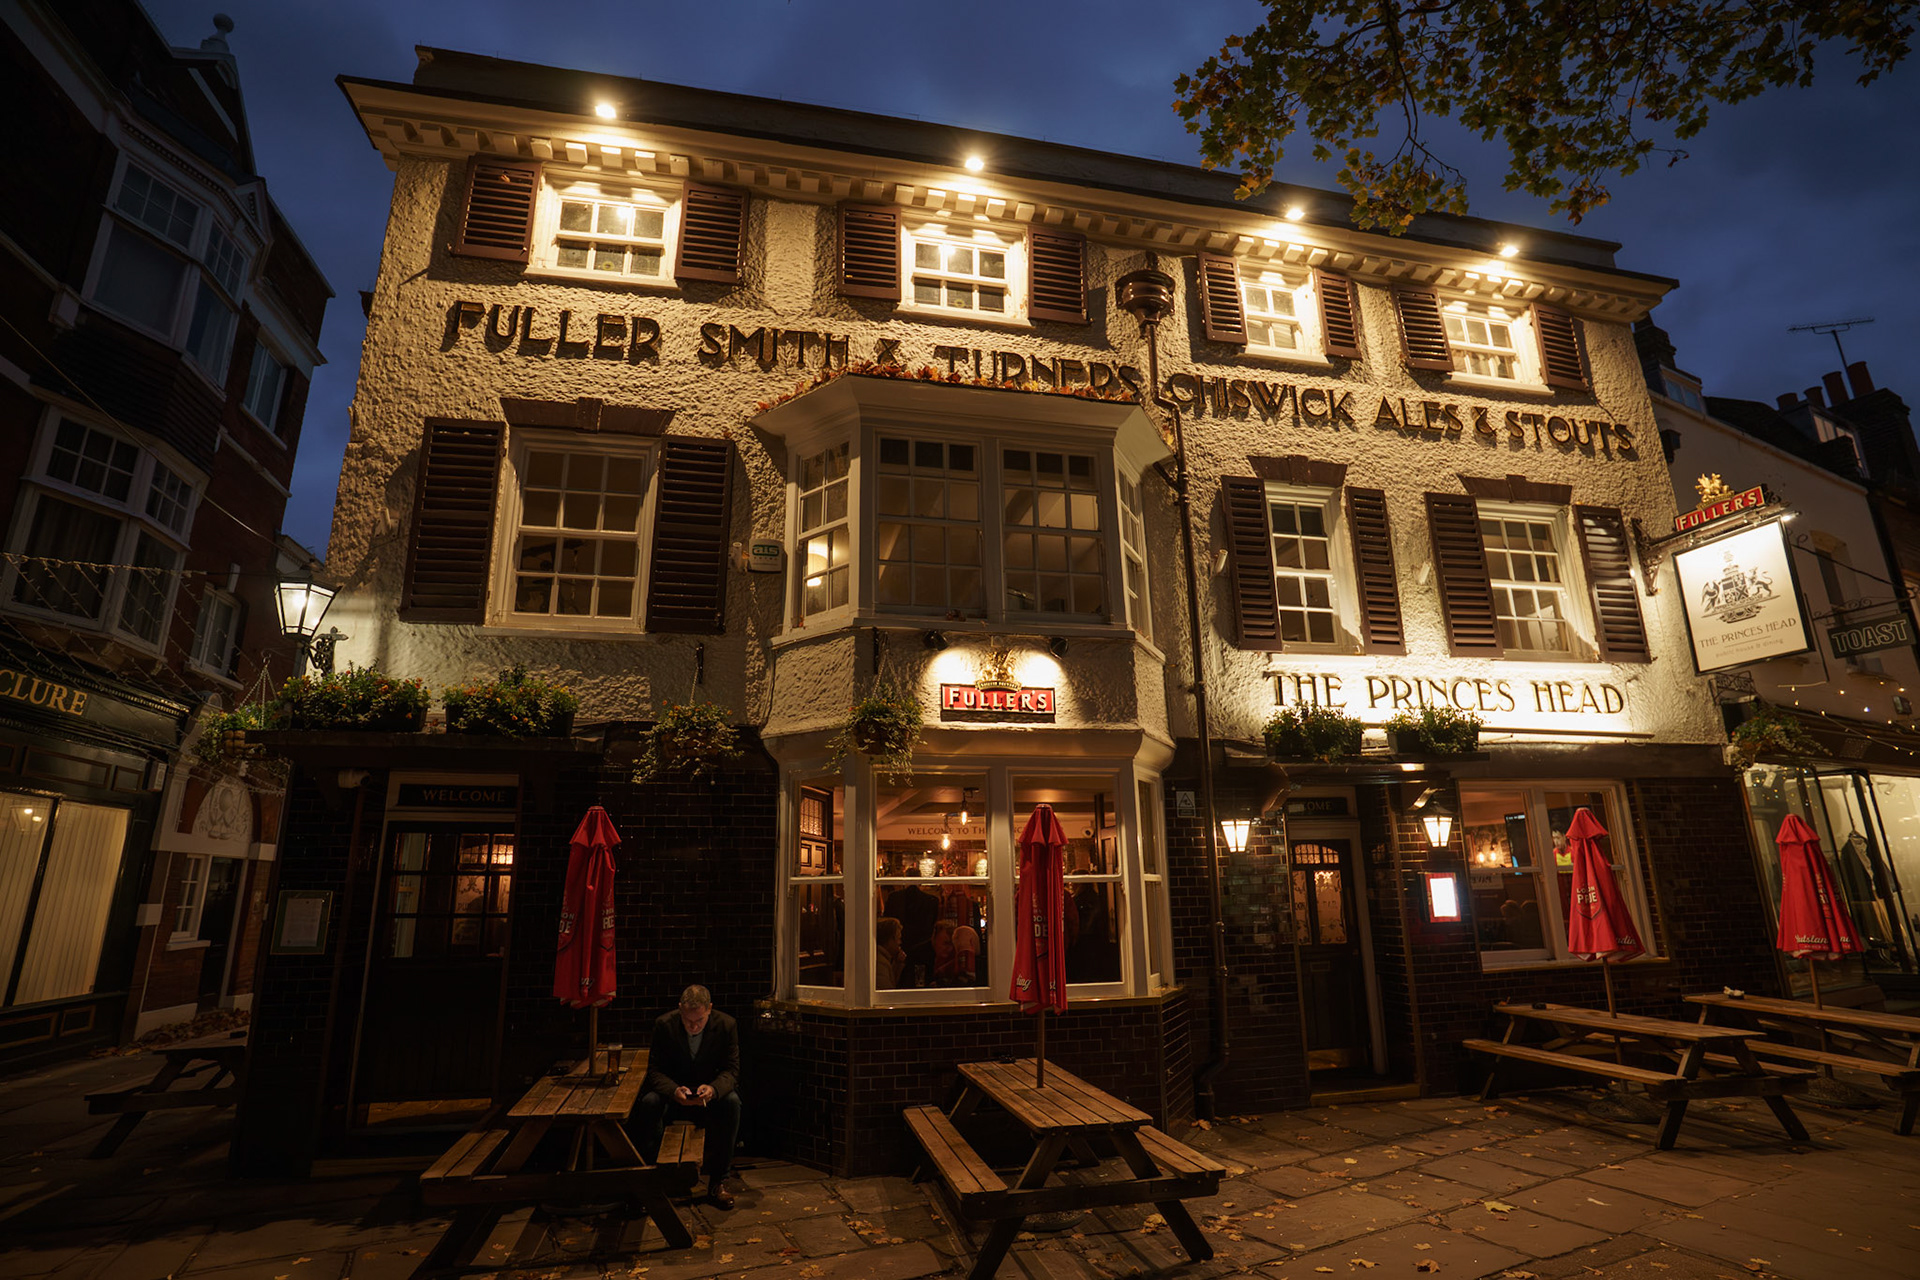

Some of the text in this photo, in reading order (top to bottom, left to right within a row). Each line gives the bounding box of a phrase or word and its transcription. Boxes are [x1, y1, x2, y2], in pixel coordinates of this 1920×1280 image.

[451, 300, 1632, 450] FULLER SMITH & TURNER'S CHISWICK ALES & STOUTS
[1678, 491, 1758, 530] FULLER'S
[1700, 618, 1797, 648] THE PRINCES HEAD
[1831, 619, 1908, 653] TOAST
[949, 687, 1048, 711] FULLER'S
[1263, 671, 1625, 714] THE PRINCES HEAD
[422, 788, 508, 802] WELCOME
[956, 827, 970, 835] TO
[972, 826, 985, 835] TH
